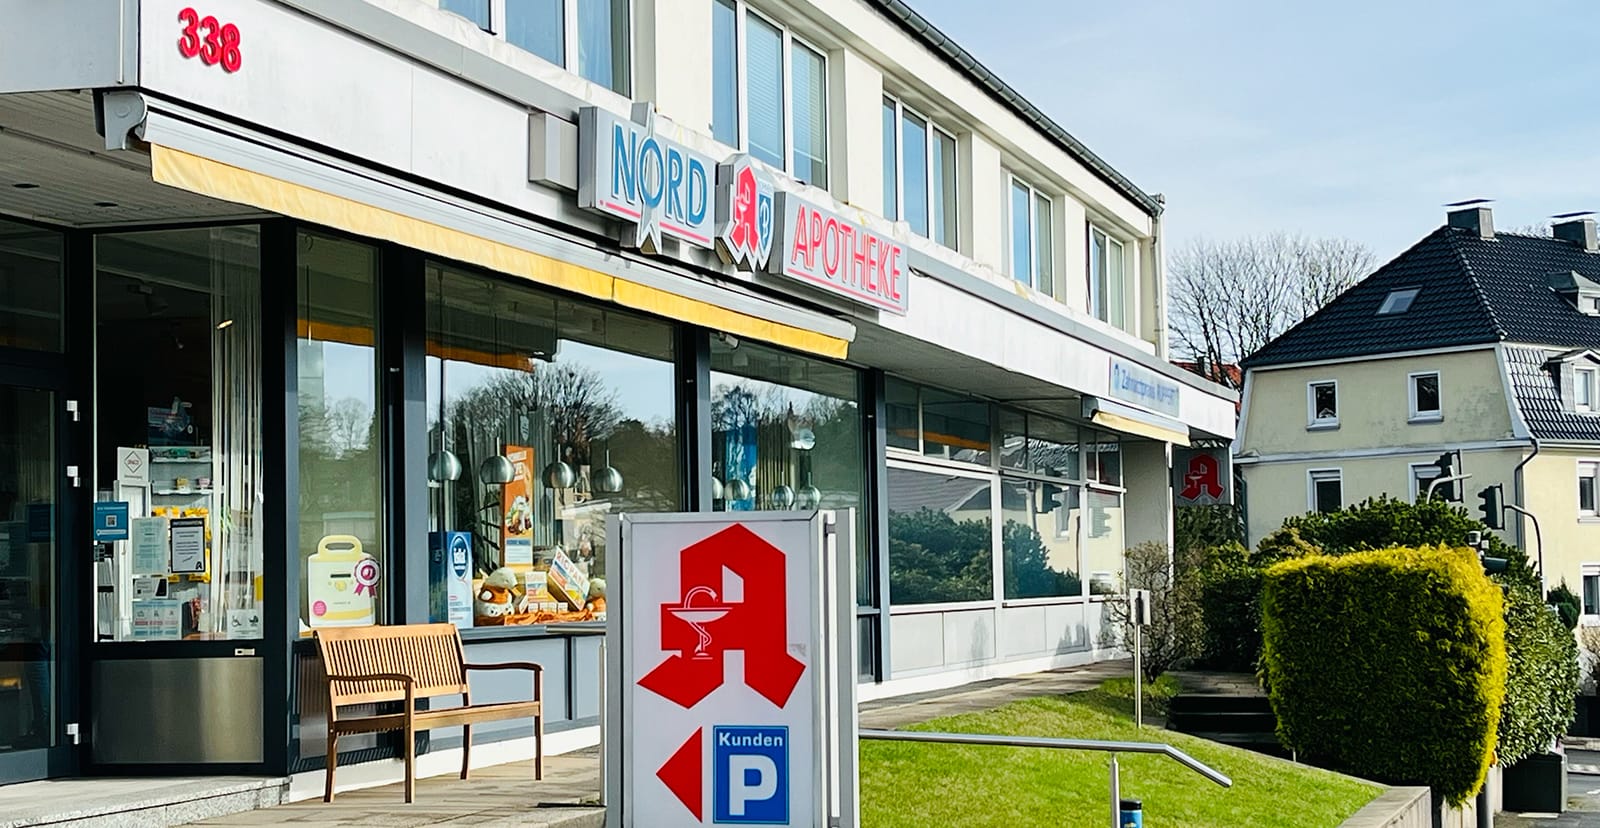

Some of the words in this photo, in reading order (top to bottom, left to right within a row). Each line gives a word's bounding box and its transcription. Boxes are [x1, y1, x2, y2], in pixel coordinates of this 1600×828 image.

[177, 7, 242, 73] 338
[612, 122, 708, 227] NORD
[792, 203, 901, 300] APOTHEKE
[719, 732, 784, 747] Kunden
[729, 754, 778, 816] P
